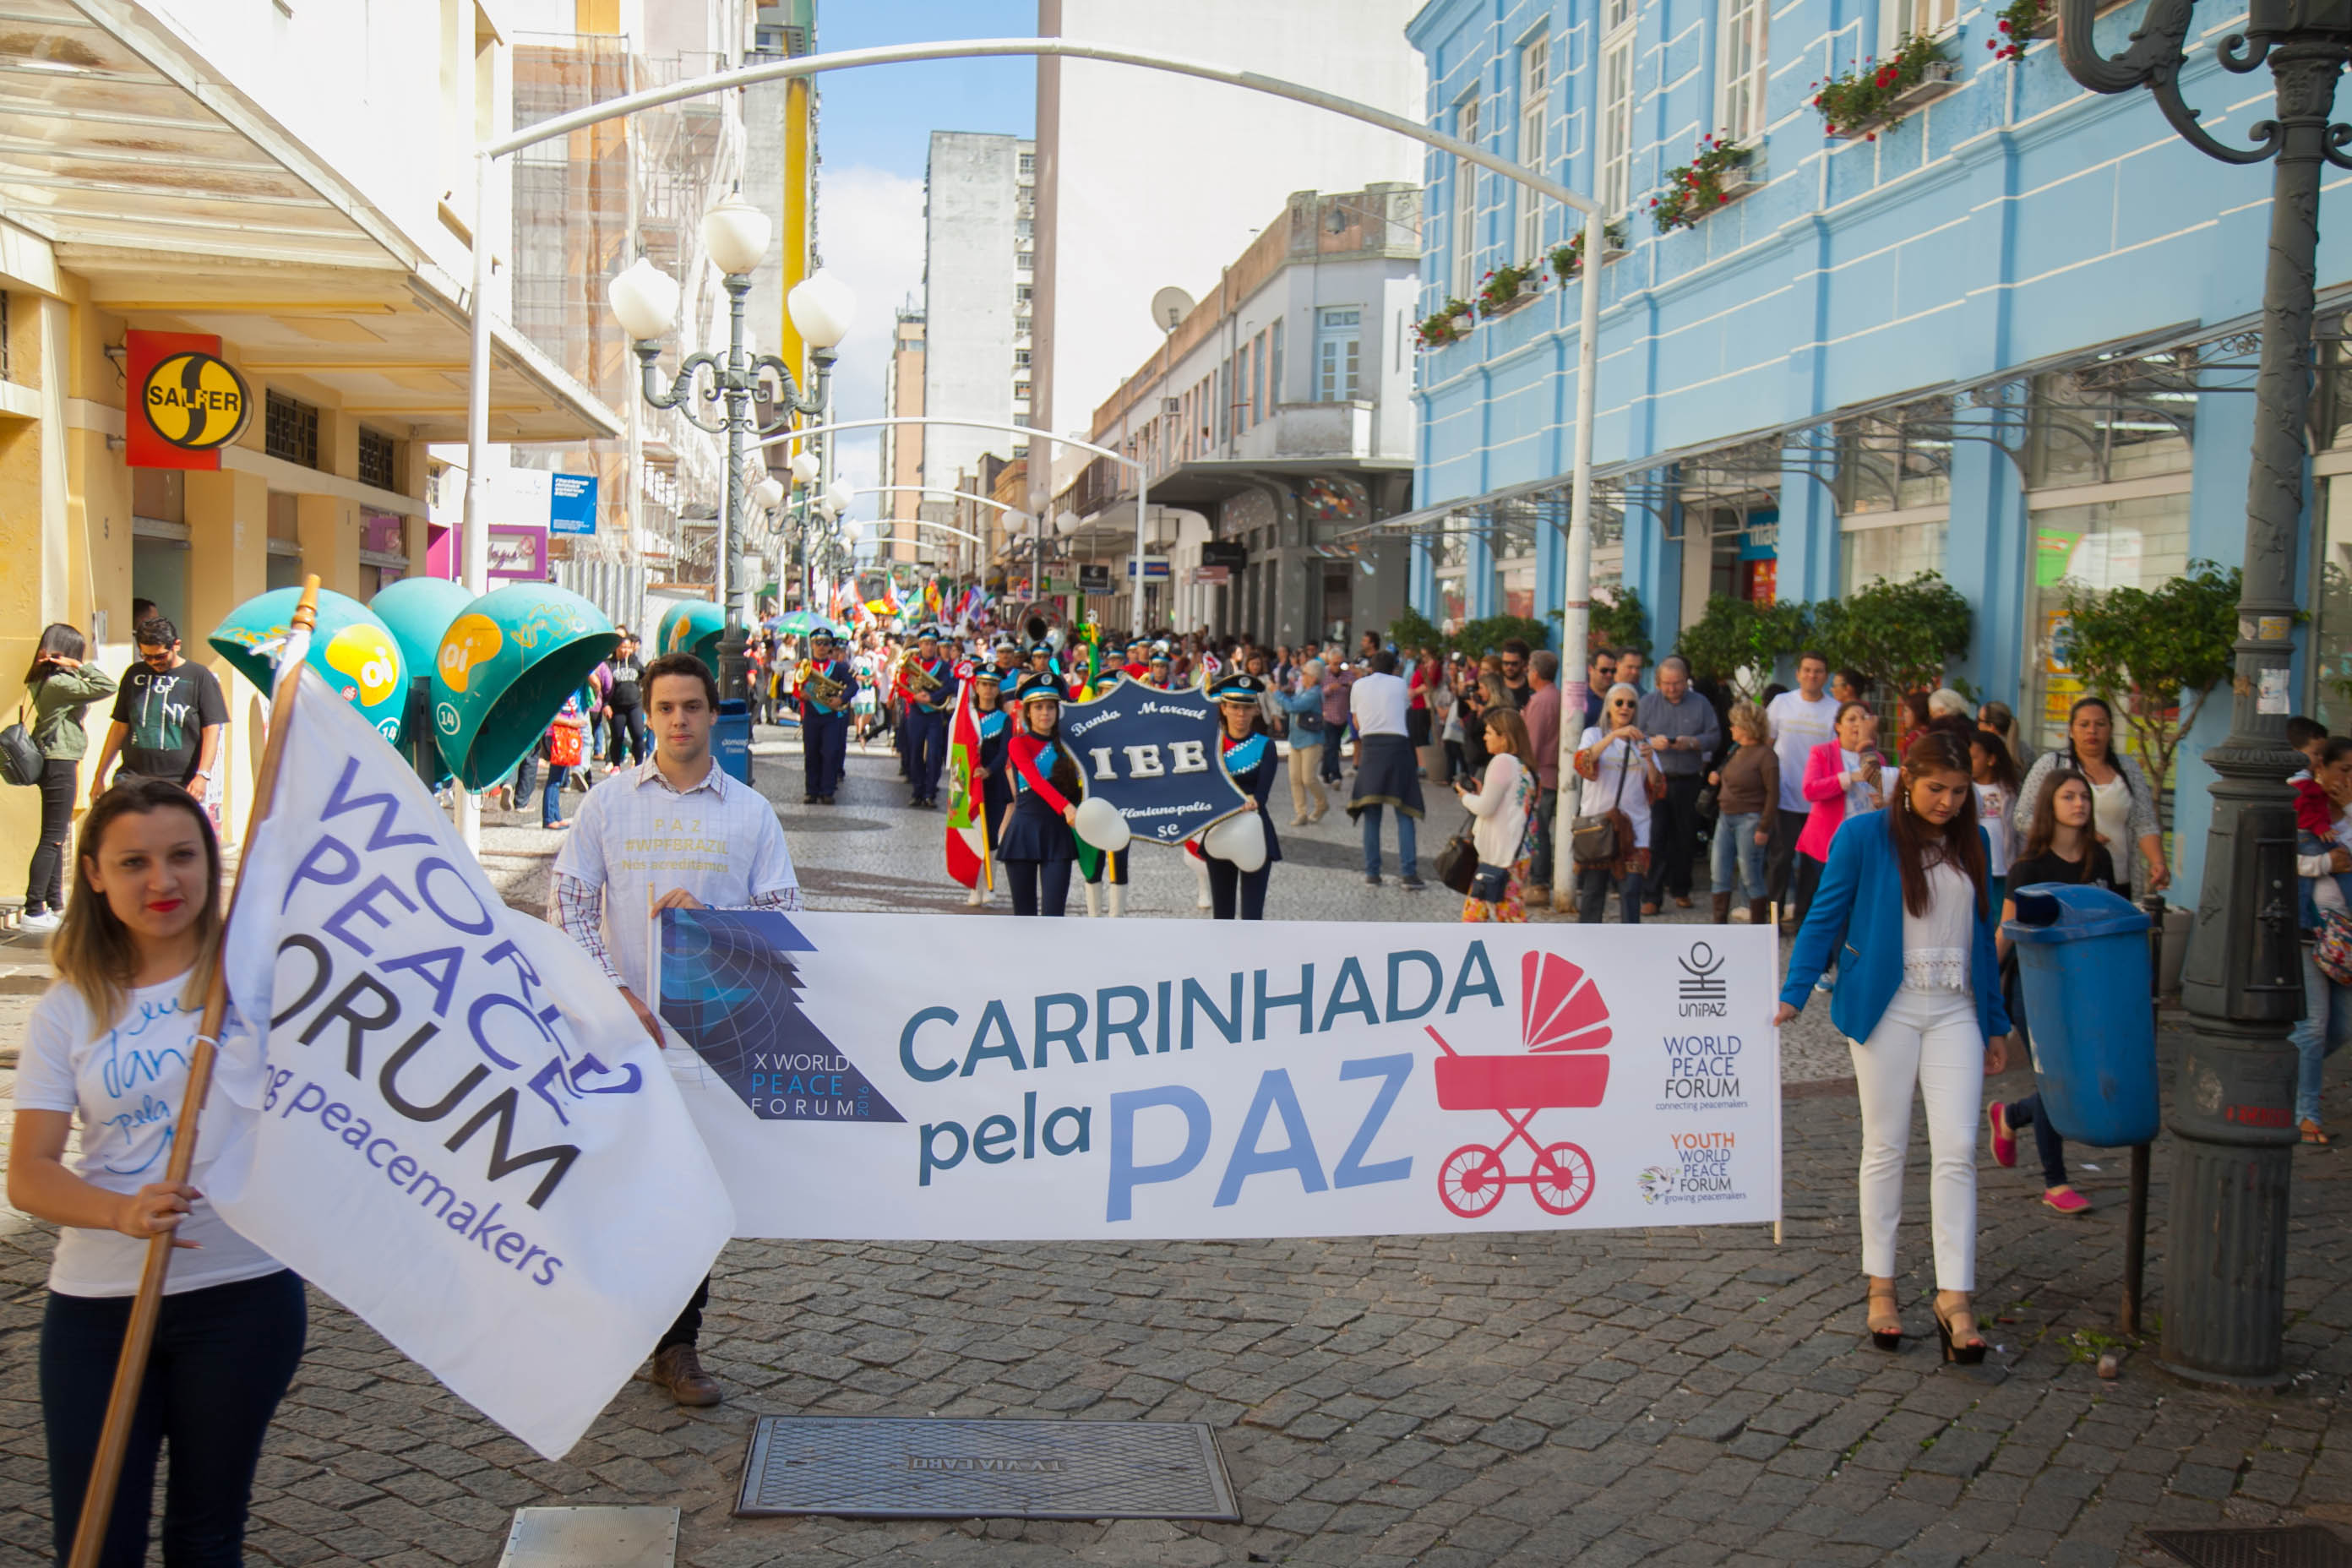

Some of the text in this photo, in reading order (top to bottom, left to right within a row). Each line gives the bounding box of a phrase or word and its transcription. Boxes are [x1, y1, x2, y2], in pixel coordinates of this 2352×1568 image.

[149, 385, 239, 411] SALFER
[440, 710, 455, 727] 14
[1070, 710, 1121, 737] Banda
[625, 839, 729, 855] #WPFBRAZIL
[319, 755, 641, 1098] WORLD
[280, 834, 569, 1127] PEACE
[899, 939, 1505, 1083] CARRINHADA
[1663, 1036, 1742, 1056] WORLD
[269, 934, 582, 1211] ORUM
[754, 1054, 851, 1072] X WORLD
[1672, 1057, 1734, 1077] PEACE
[751, 1073, 843, 1096] PEACE
[1665, 1078, 1740, 1099] FORUM
[751, 1097, 854, 1116] FORUM
[858, 1086, 869, 1116] 2016
[1656, 1100, 1748, 1112] connecting peacemakers
[101, 1094, 171, 1146] pela
[919, 1053, 1413, 1222] pela PAZ
[1671, 1132, 1734, 1149] YOUTH
[1679, 1149, 1731, 1162] WORLD
[1684, 1163, 1728, 1177] PEACE
[281, 1081, 564, 1286] peacemakers
[1680, 1177, 1732, 1192] FORUM
[1664, 1192, 1746, 1205] growing peacemakers
